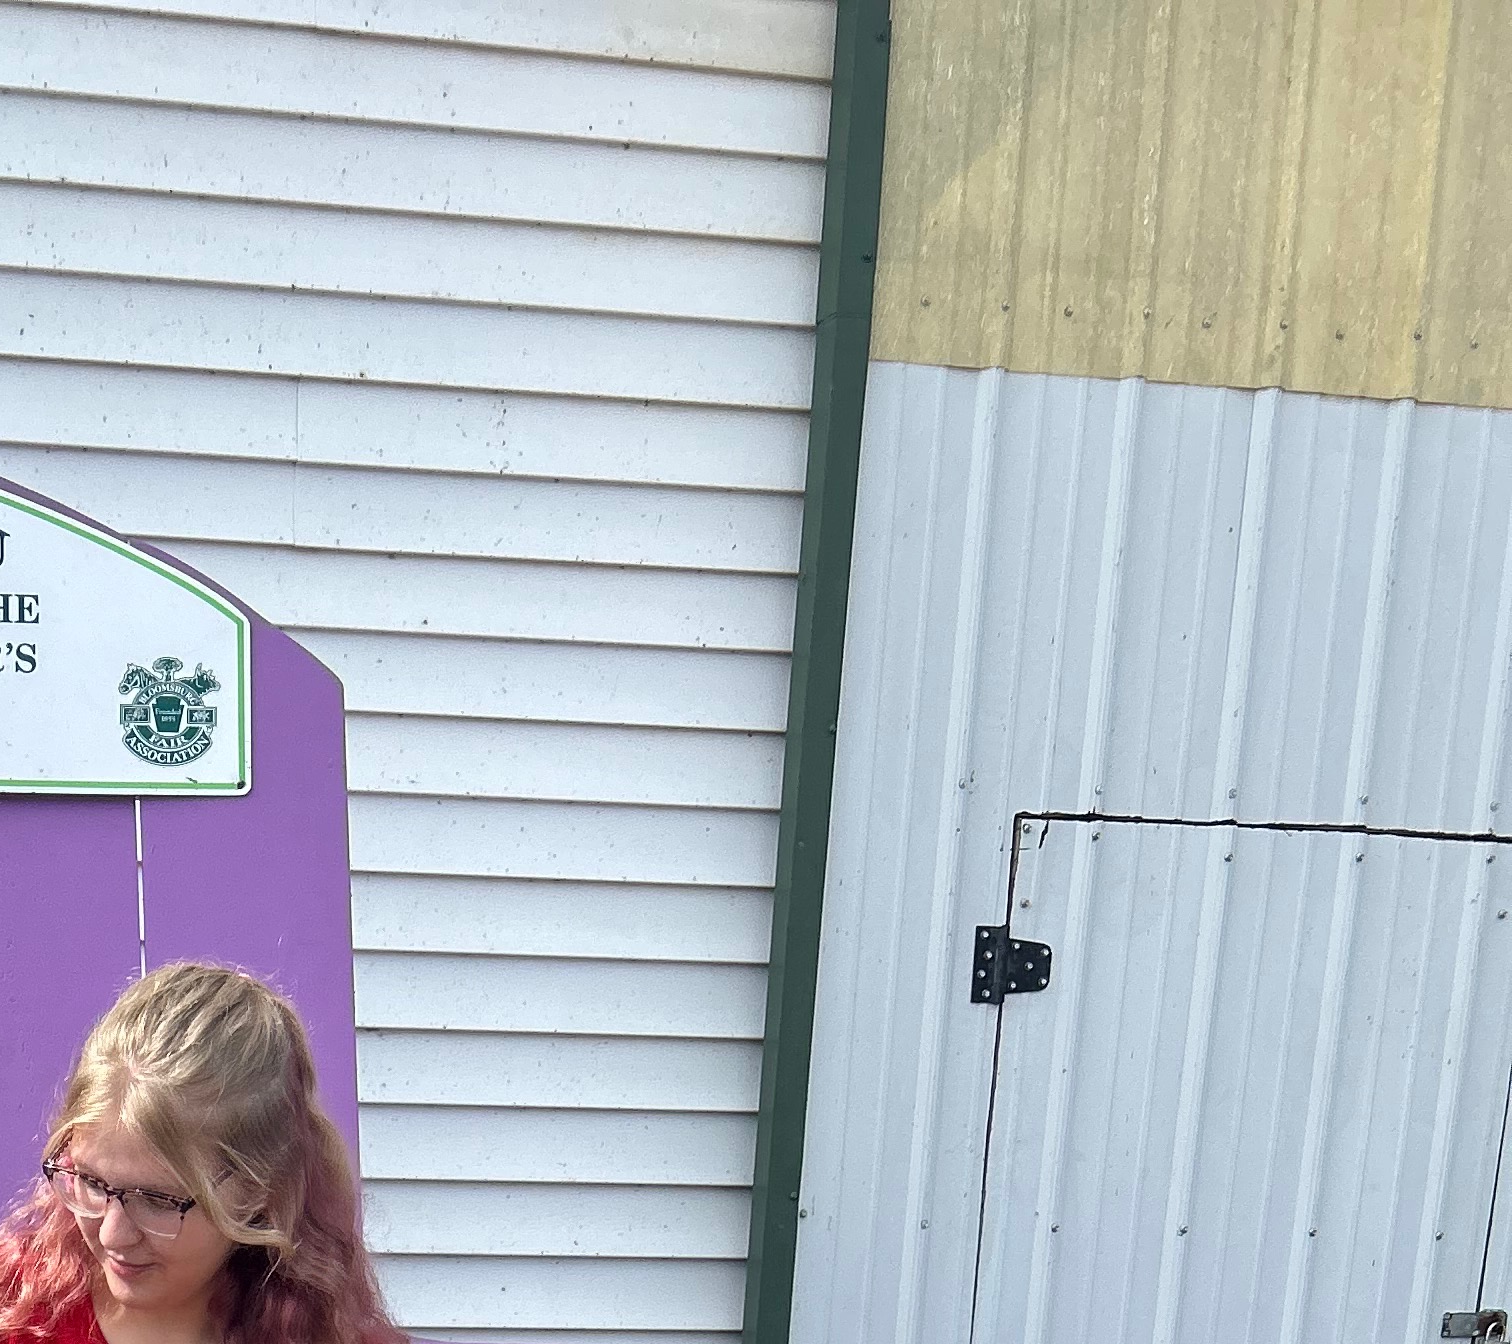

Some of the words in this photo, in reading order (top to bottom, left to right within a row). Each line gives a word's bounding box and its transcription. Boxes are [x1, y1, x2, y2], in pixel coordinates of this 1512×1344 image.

[138, 683, 197, 705] BLOOMSBURG
[127, 736, 209, 763] ASSOCIATION
[149, 735, 188, 749] FAIR
